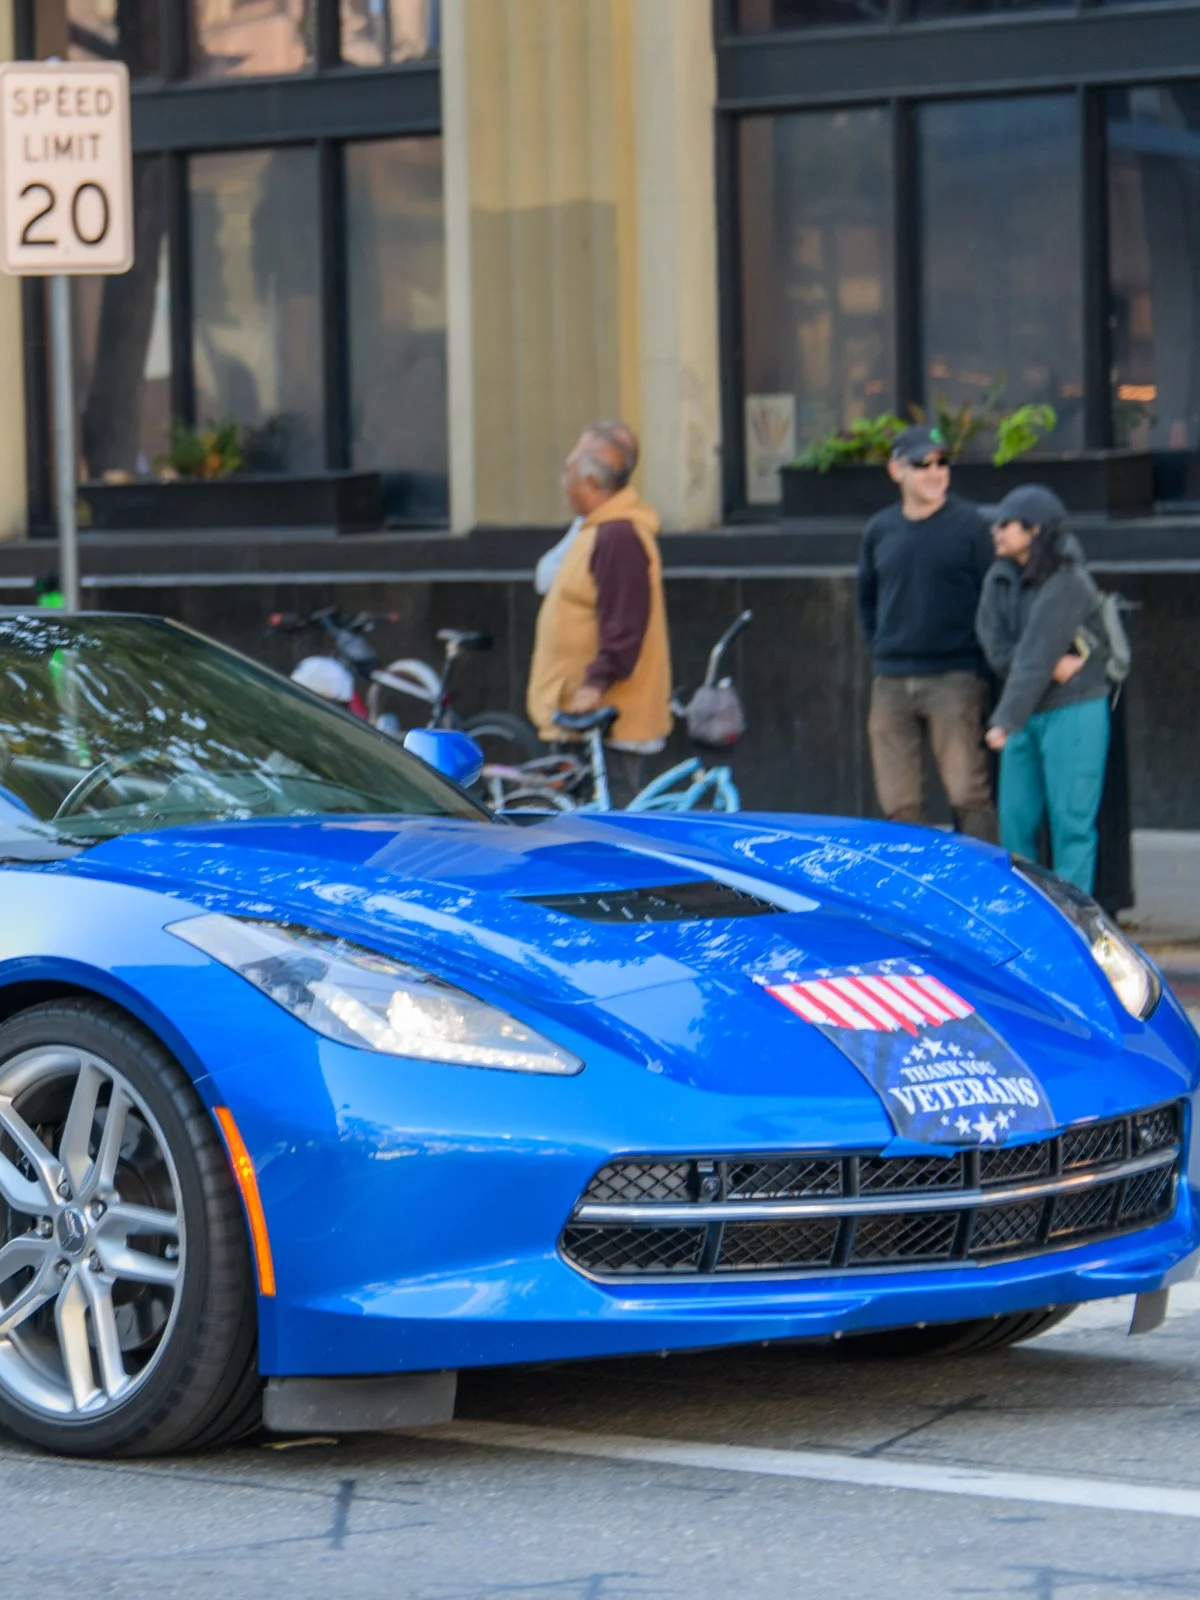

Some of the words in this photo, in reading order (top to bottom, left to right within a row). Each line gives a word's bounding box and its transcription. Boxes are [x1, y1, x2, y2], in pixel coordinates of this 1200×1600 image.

[12, 85, 113, 118] SPEED
[22, 133, 102, 163] LIMIT
[19, 182, 111, 246] 20
[900, 1060, 966, 1083] THANK
[958, 1059, 998, 1076] YOU
[888, 1077, 1040, 1115] VETERANS
